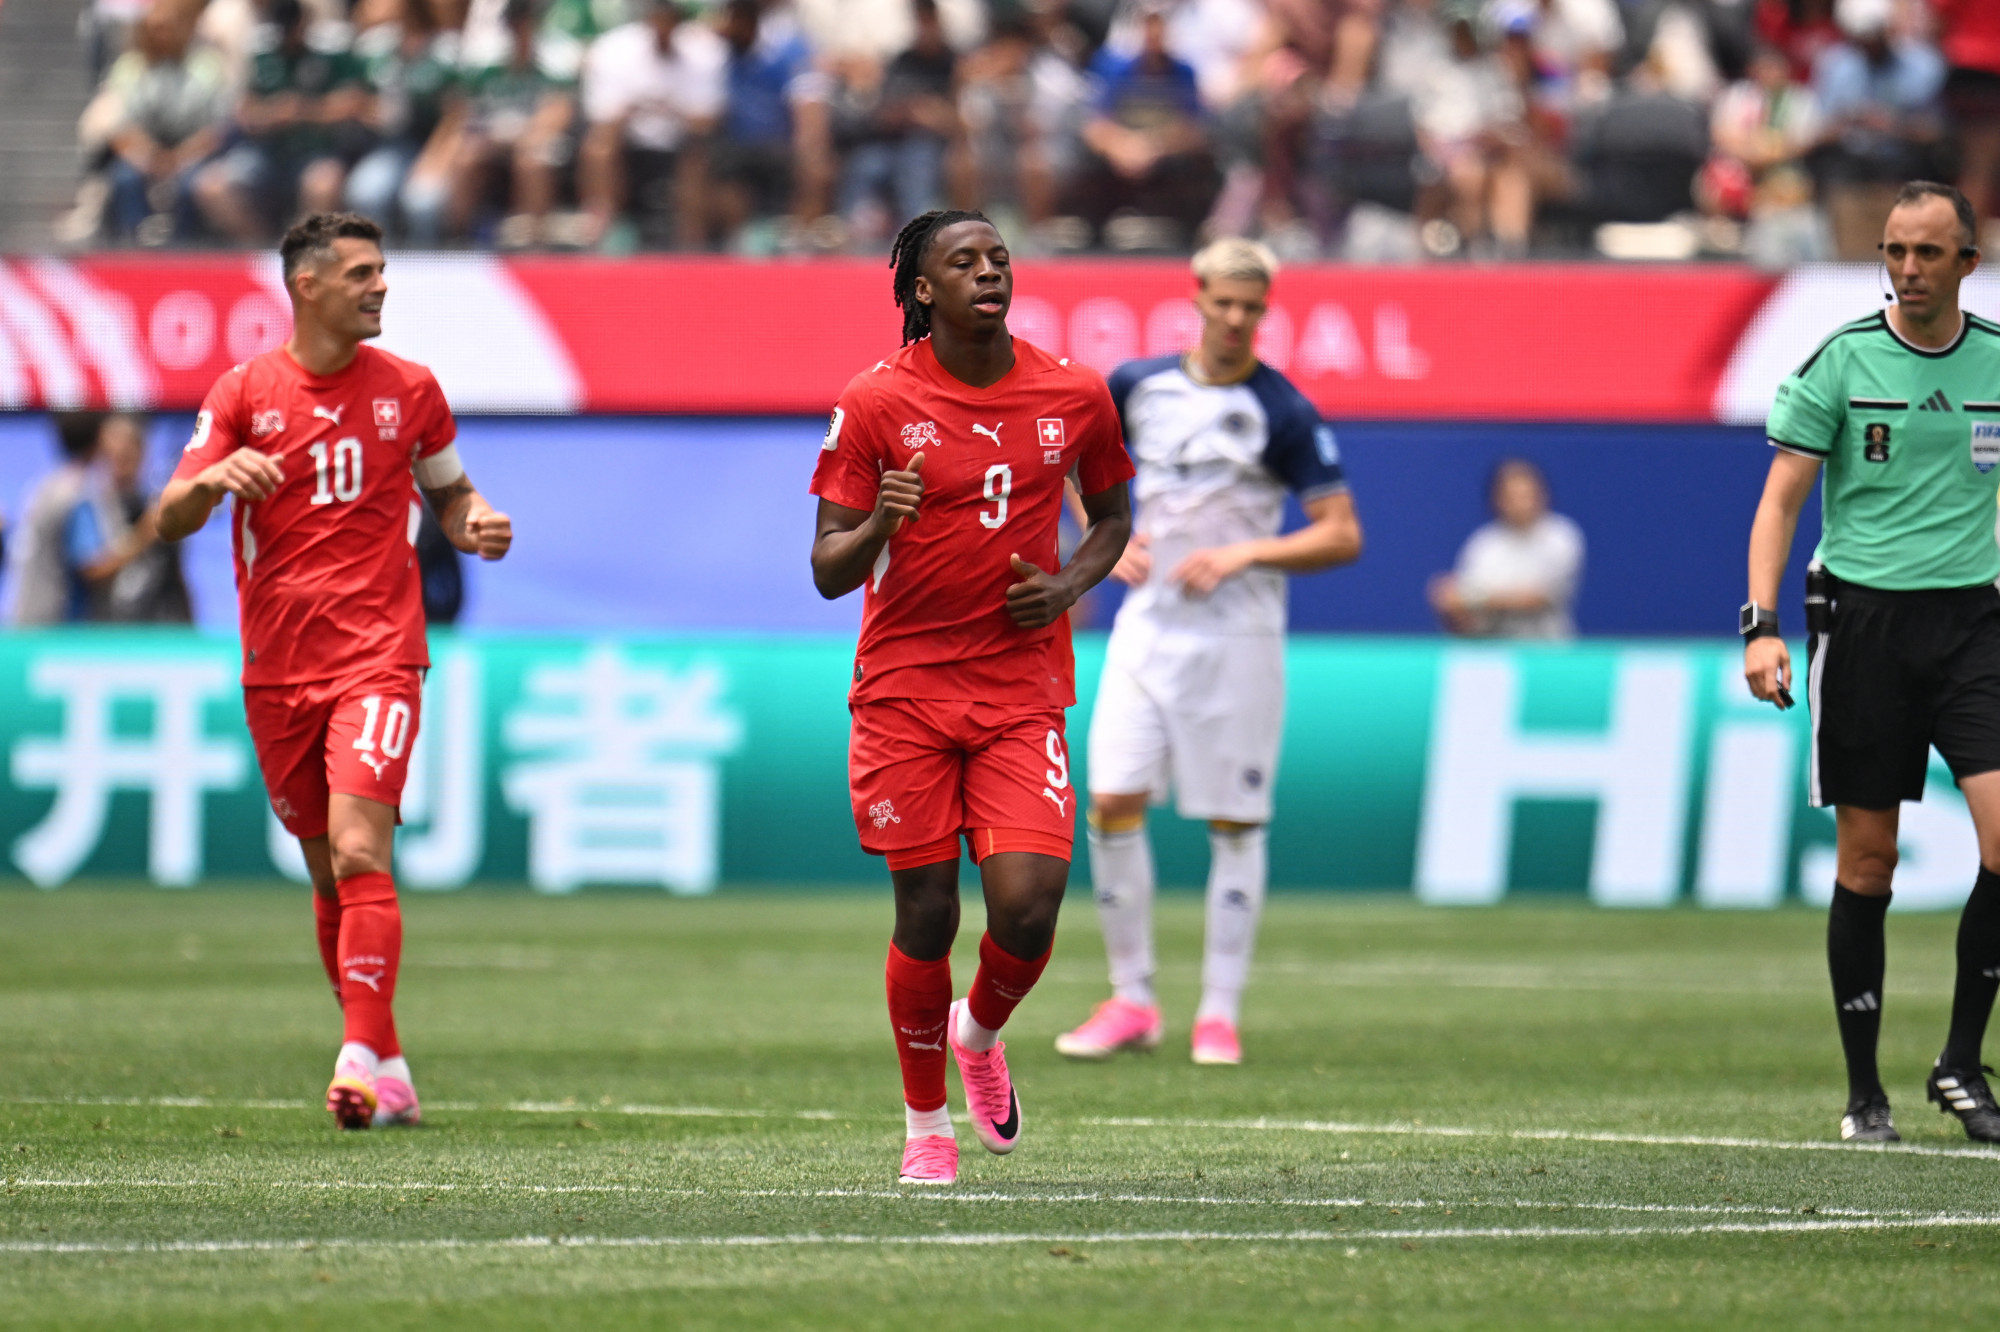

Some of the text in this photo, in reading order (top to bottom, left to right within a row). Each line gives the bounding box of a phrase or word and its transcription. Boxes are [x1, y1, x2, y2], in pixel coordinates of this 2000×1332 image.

[307, 436, 363, 505] 10
[979, 464, 1012, 529] 9
[352, 695, 411, 760] 10
[1046, 729, 1068, 790] 9
